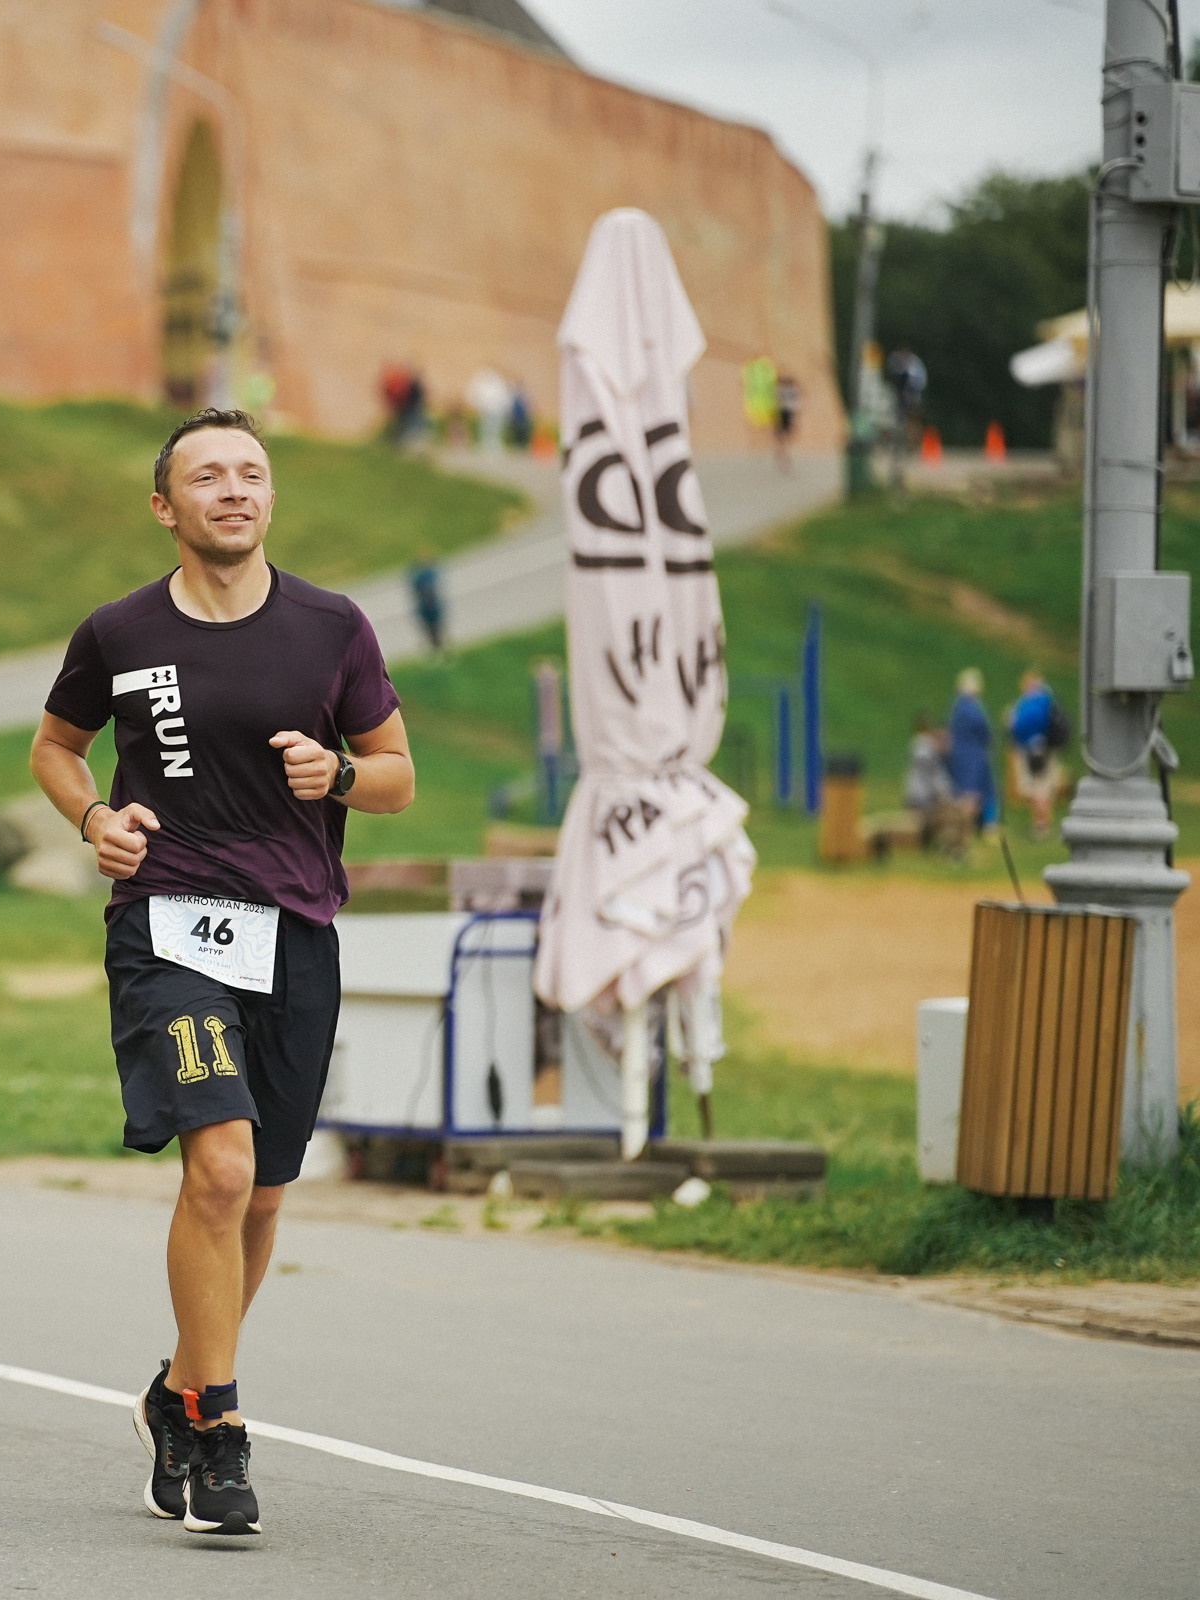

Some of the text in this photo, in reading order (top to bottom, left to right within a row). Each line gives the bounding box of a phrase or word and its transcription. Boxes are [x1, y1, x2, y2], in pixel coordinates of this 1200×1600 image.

[148, 685, 194, 778] RUN
[168, 895, 265, 914] VOLKHOVMAN 2023
[190, 915, 234, 946] 46
[197, 946, 224, 956] АРТУР
[167, 1014, 239, 1085] 11
